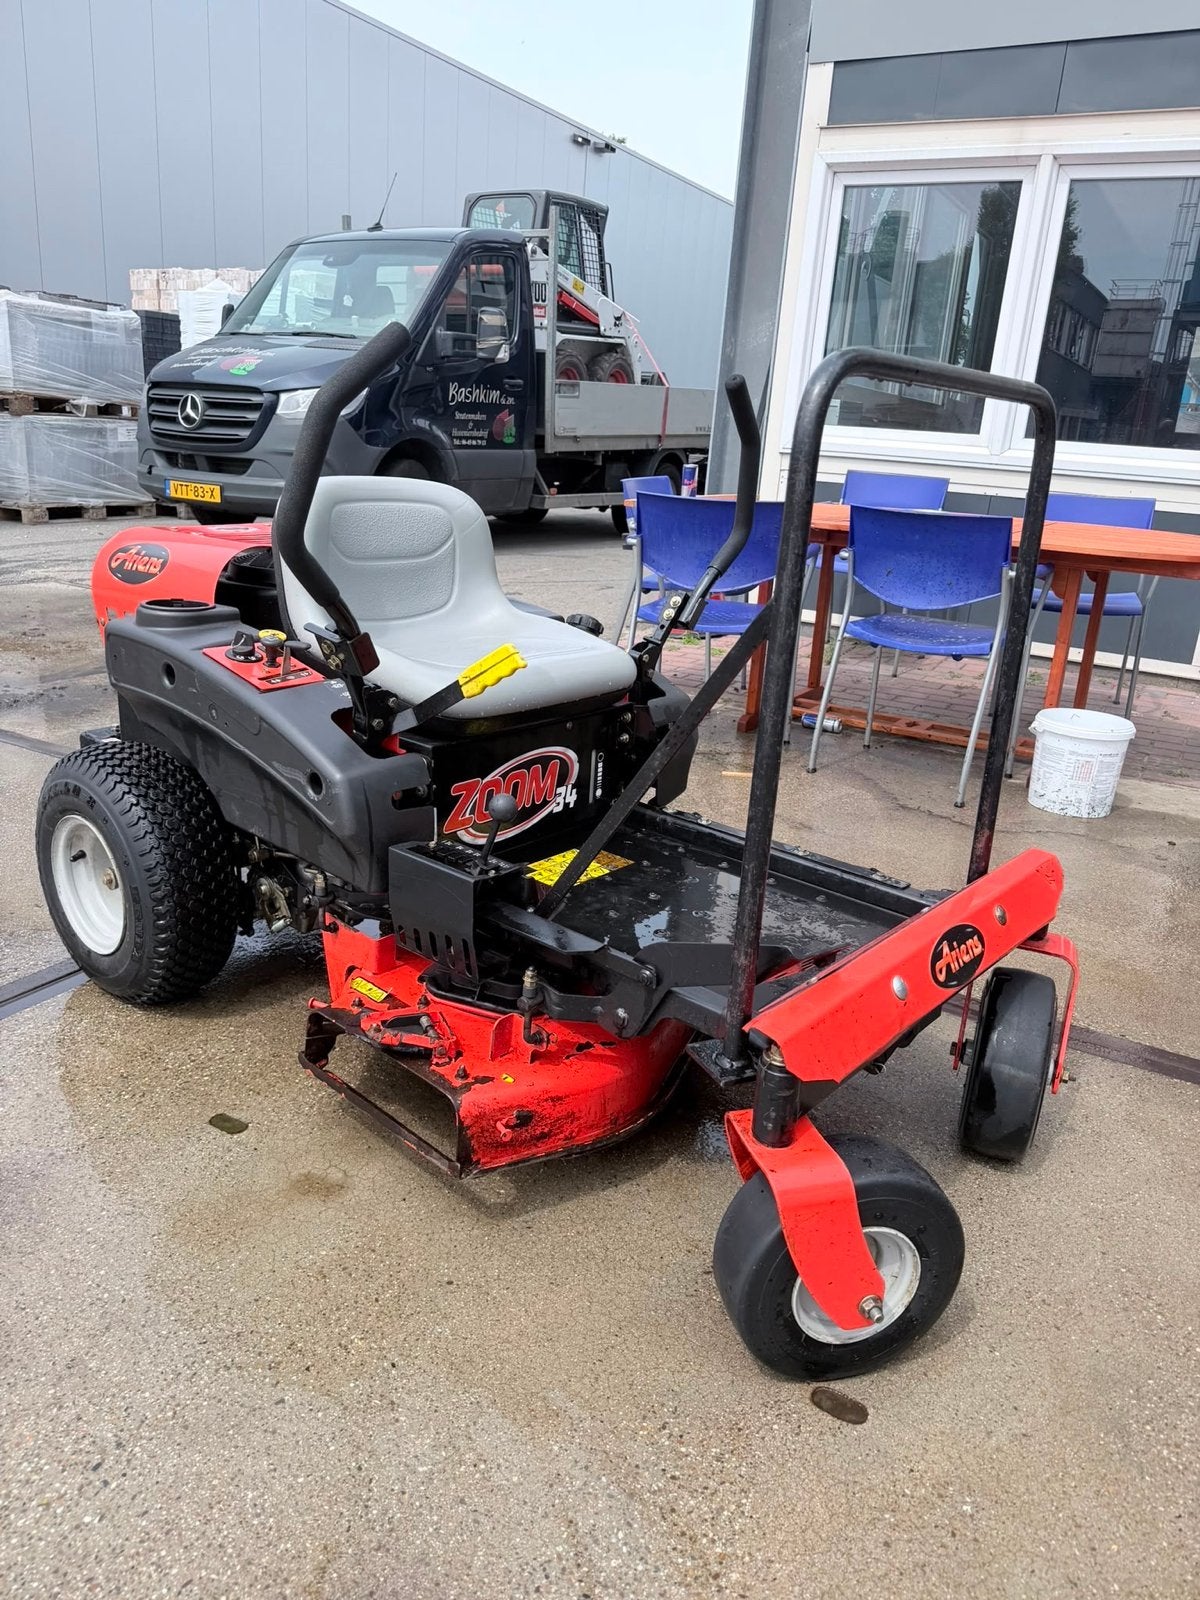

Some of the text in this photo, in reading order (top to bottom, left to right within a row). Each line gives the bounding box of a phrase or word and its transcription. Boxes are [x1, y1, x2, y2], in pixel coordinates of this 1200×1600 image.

[448, 381, 500, 406] Bashkim
[172, 482, 216, 500] VTT-83-X
[110, 545, 164, 575] Ariens
[443, 759, 578, 835] ZOOM 34
[935, 934, 983, 983] Ariens
